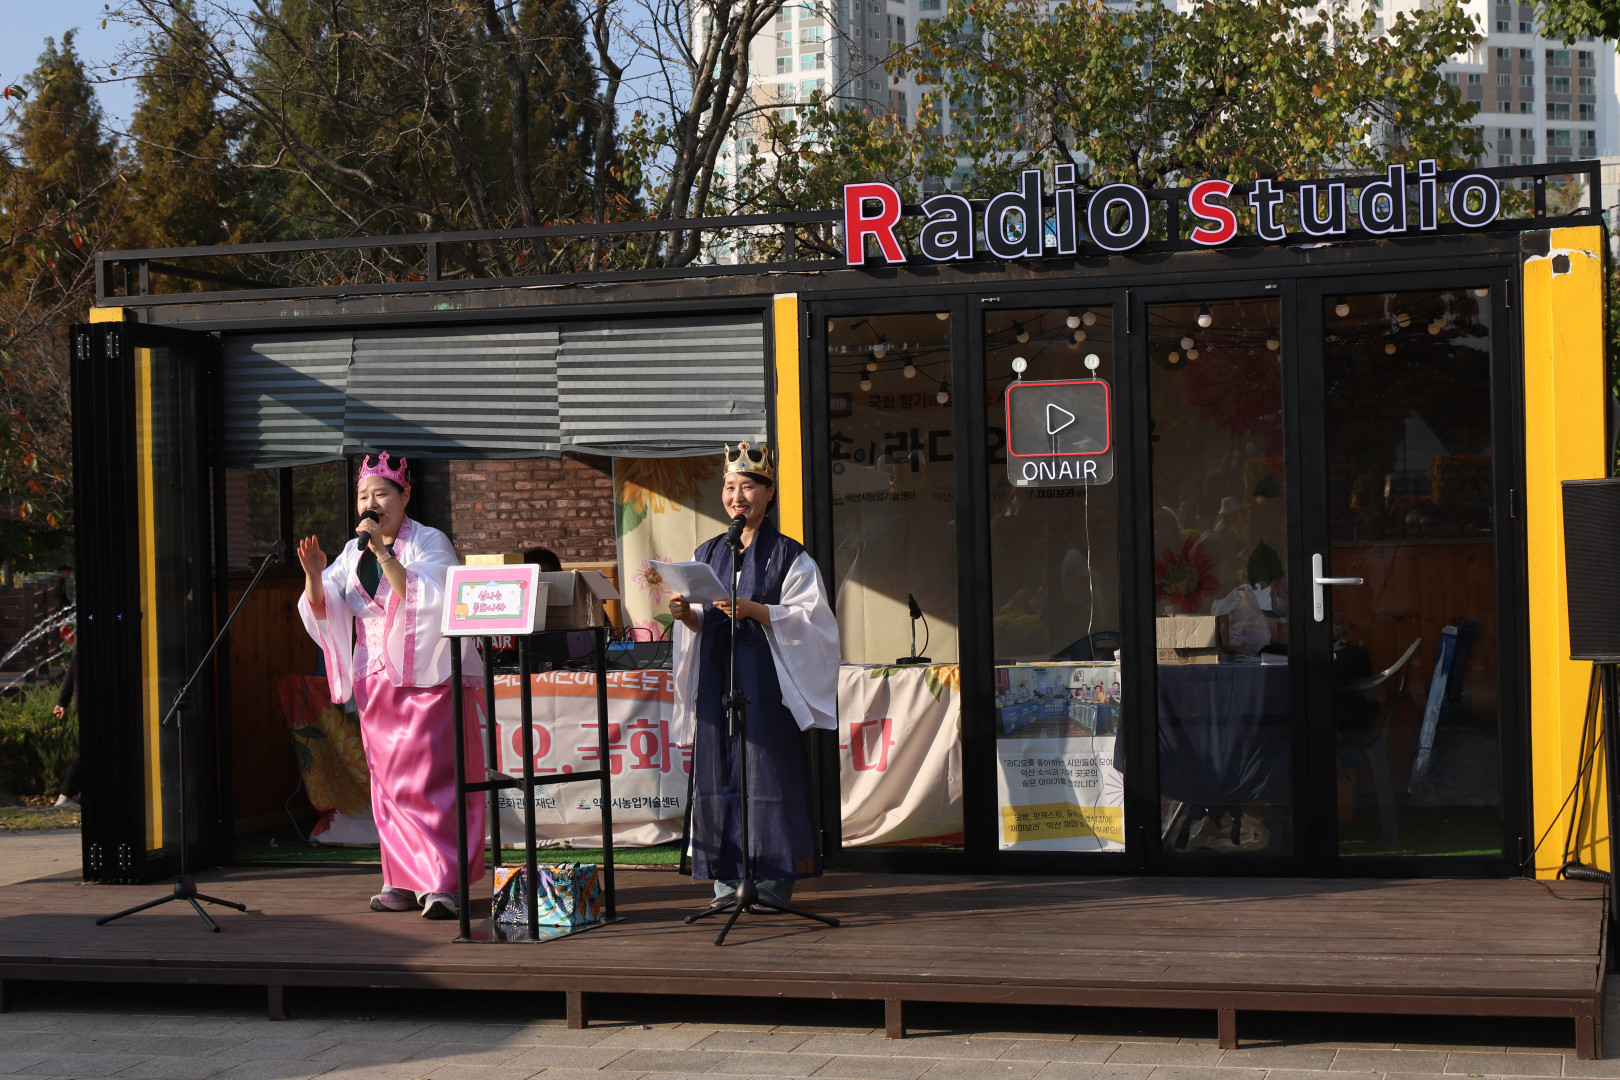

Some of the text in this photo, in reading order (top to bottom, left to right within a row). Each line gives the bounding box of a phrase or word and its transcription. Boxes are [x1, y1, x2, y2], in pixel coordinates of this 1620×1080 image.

[843, 163, 1149, 265] Radio
[868, 392, 895, 410] 국화
[845, 490, 916, 503] 익산시농업기술센터
[478, 590, 503, 602] 신나는
[491, 635, 512, 649] AIR
[1099, 758, 1113, 766] 모여
[1020, 768, 1035, 777] 익산
[592, 797, 680, 810] 익시농업기술센터
